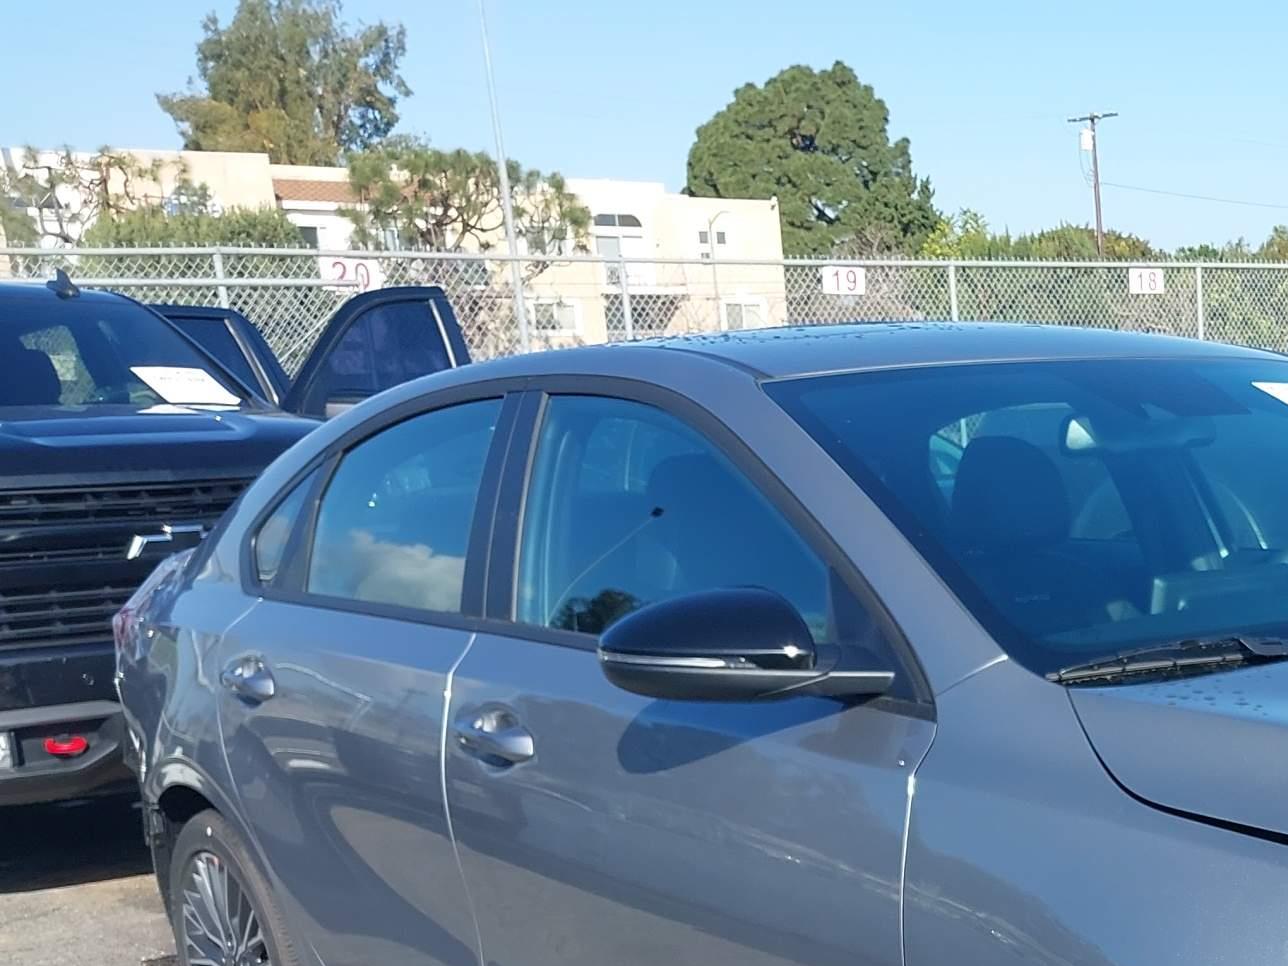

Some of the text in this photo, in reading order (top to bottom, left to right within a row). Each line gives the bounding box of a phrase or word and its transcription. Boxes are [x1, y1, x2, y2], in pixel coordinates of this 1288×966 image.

[332, 261, 370, 289] 20
[833, 270, 857, 291] 19
[1138, 272, 1157, 291] 18
